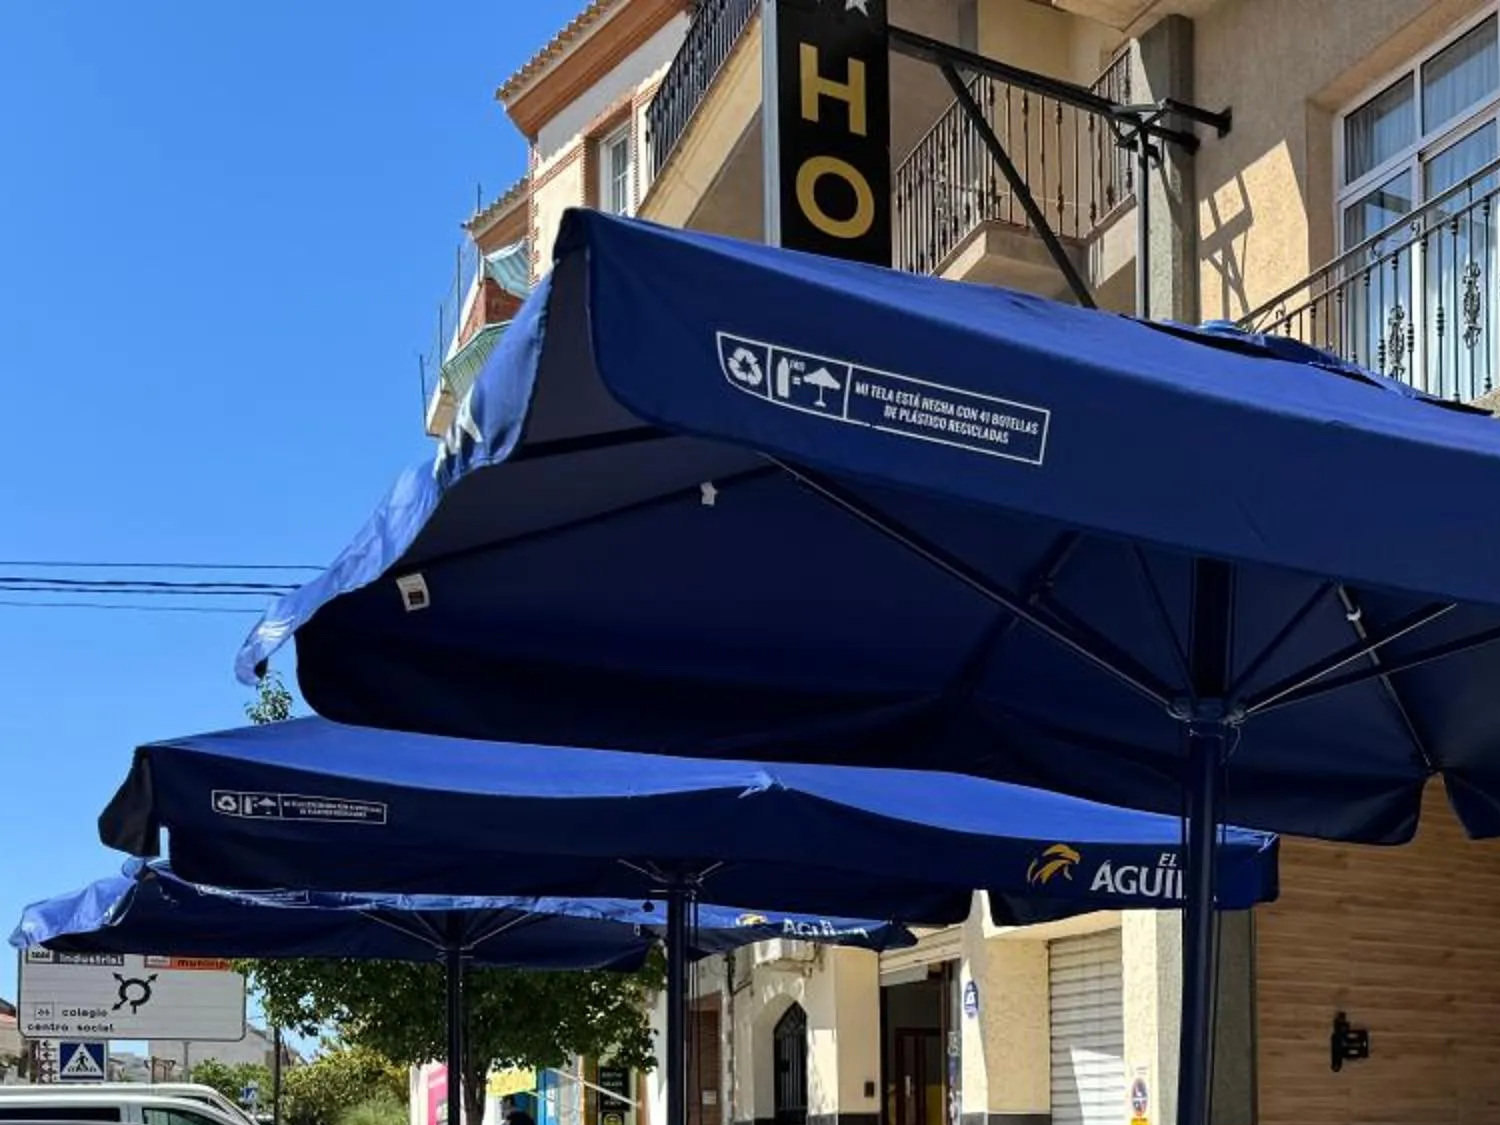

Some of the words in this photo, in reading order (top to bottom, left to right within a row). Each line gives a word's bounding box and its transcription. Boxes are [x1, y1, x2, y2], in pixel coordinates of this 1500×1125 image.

[855, 381, 869, 396] MI
[871, 385, 893, 401] TELA
[896, 391, 920, 407] ESTÁ
[921, 398, 954, 416] HECHA
[956, 405, 980, 420] CON
[991, 413, 1040, 435] BOTELLAS
[884, 405, 897, 419] DE
[899, 408, 947, 431] PLÁSTICO
[948, 418, 1009, 444] RECICLADAS
[1158, 853, 1177, 867] EL
[1090, 859, 1217, 902] ÁGUIL
[62, 1008, 108, 1018] colegio
[27, 1023, 69, 1032] centro
[77, 1023, 114, 1032] social
